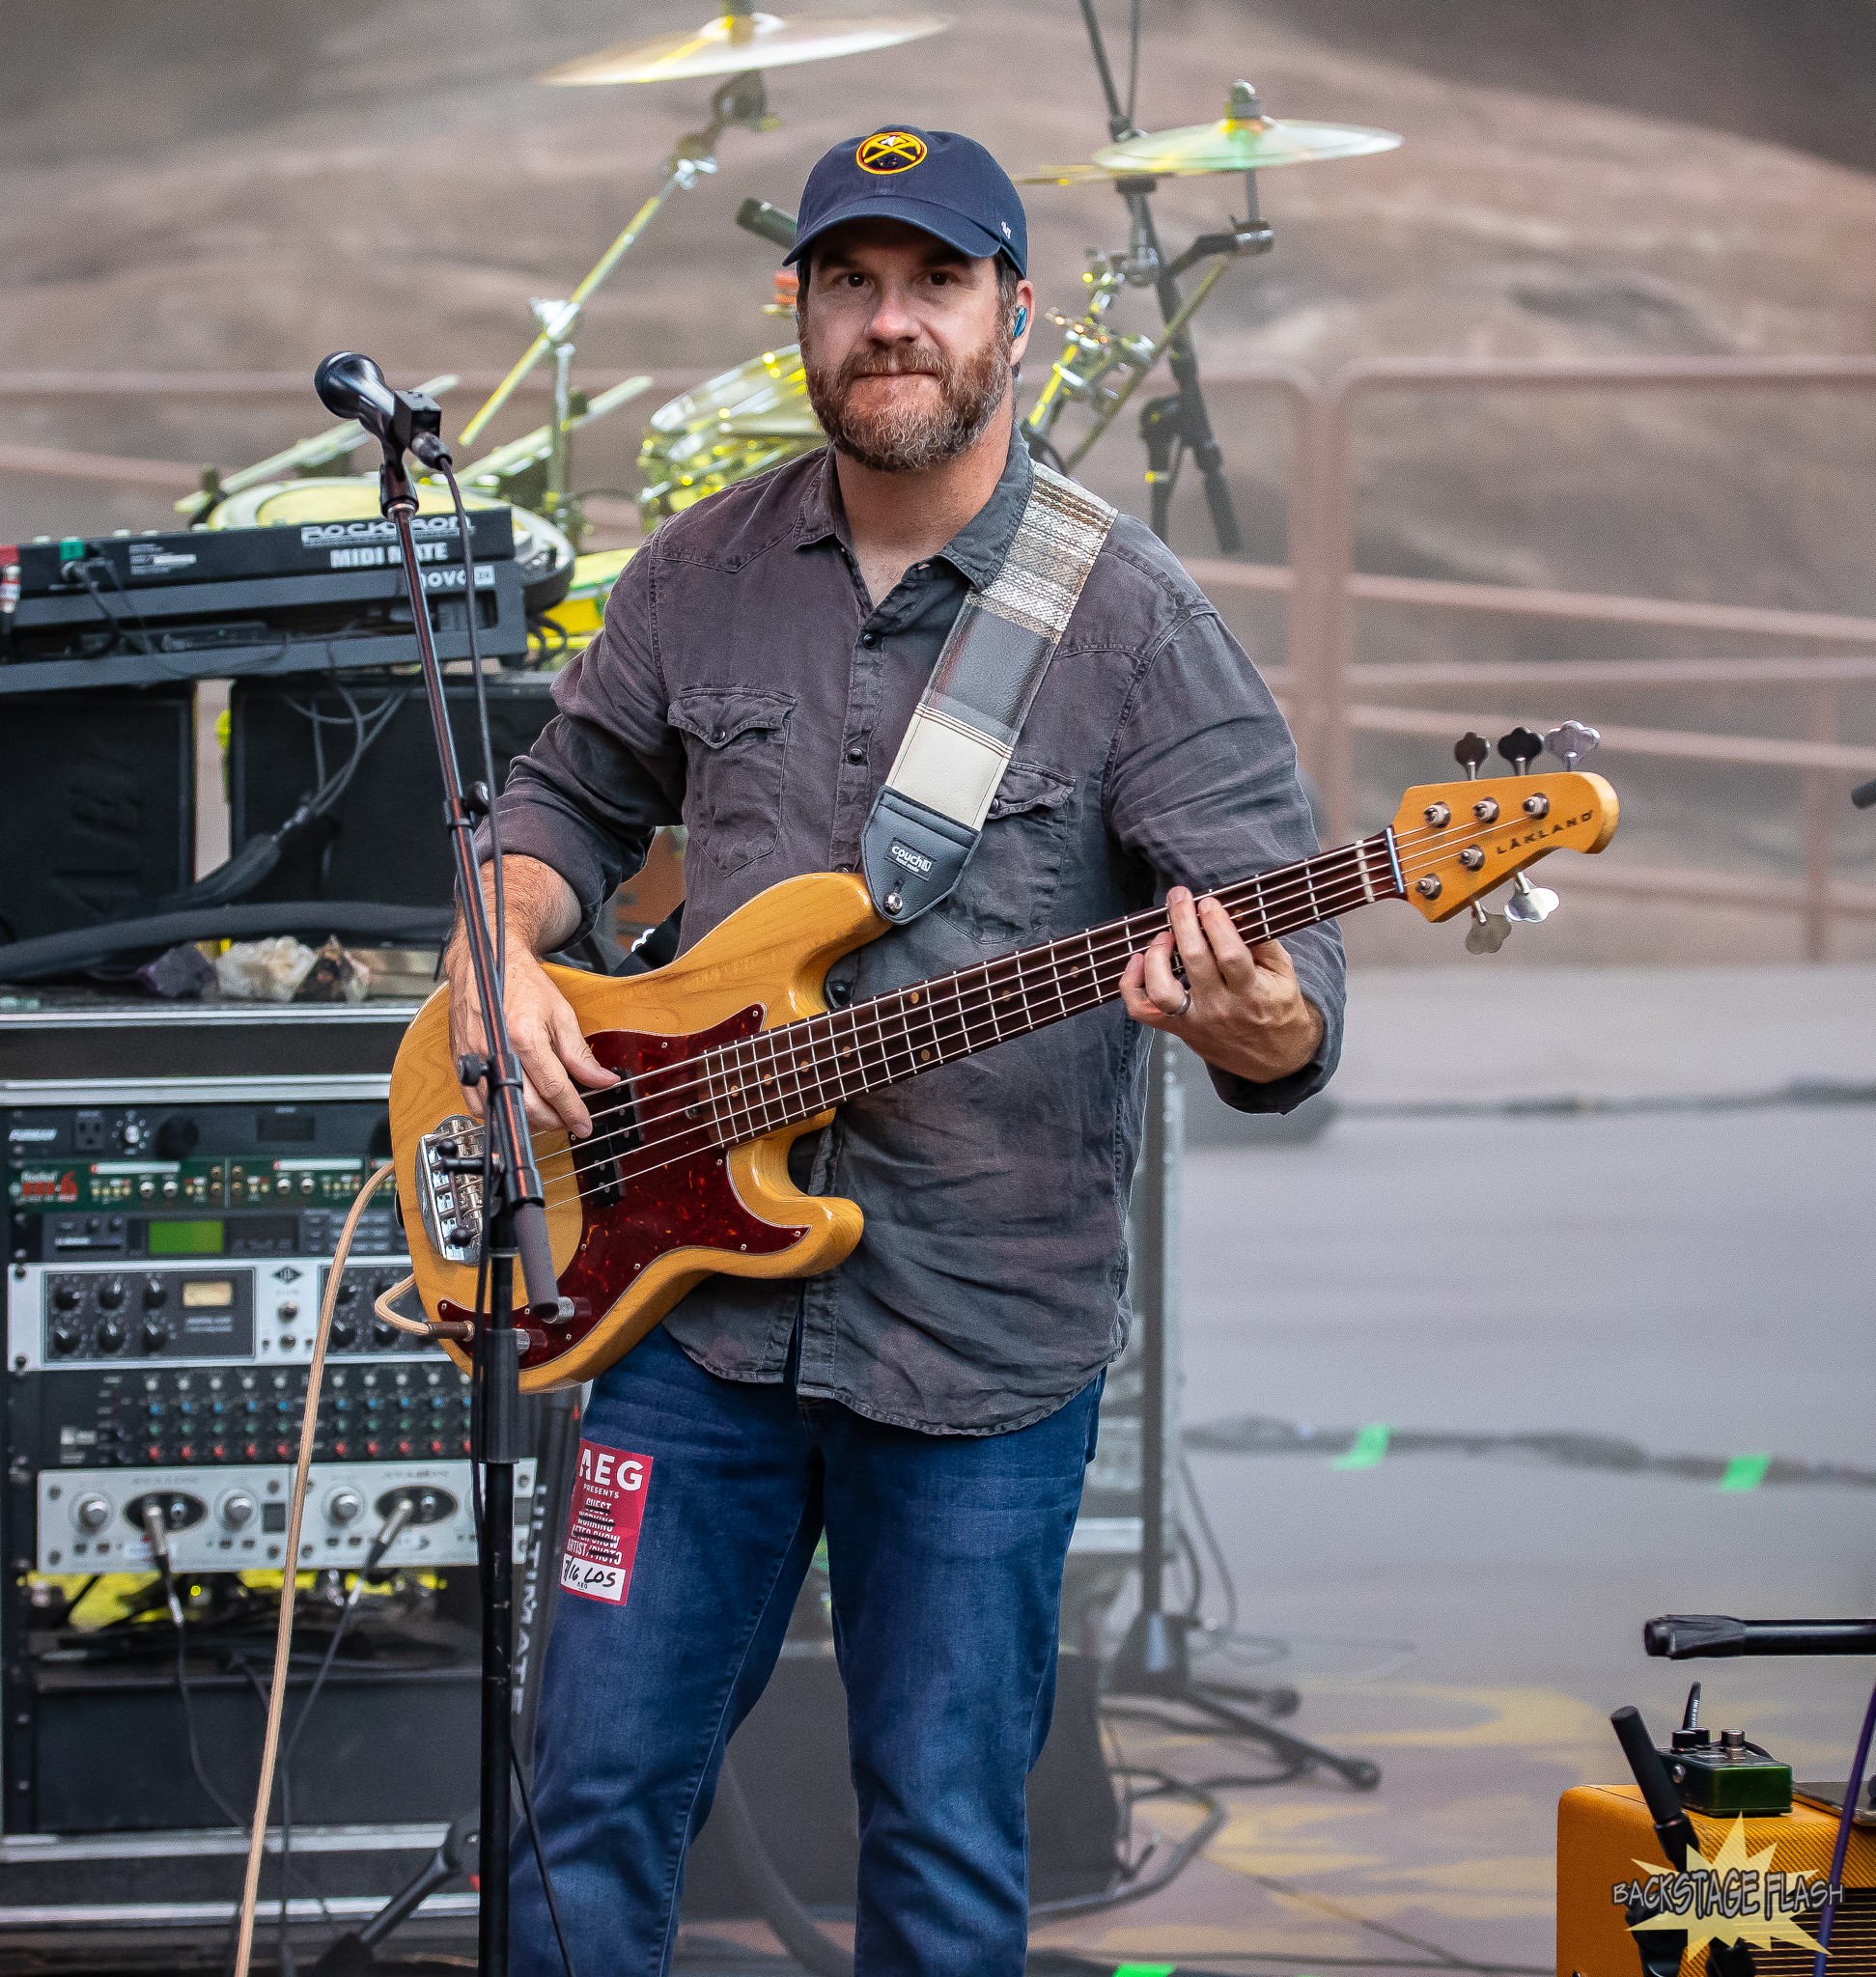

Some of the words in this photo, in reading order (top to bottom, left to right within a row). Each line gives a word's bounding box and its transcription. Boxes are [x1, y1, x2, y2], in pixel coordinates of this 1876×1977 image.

[329, 546, 385, 568] MIDI
[1497, 809, 1593, 854] LAKLAND
[891, 846, 923, 868] couch
[579, 1448, 644, 1491] AEG
[583, 1483, 620, 1499] PRESENTS
[583, 1567, 616, 1588] LOS
[512, 1484, 547, 1715] ULTIMATE
